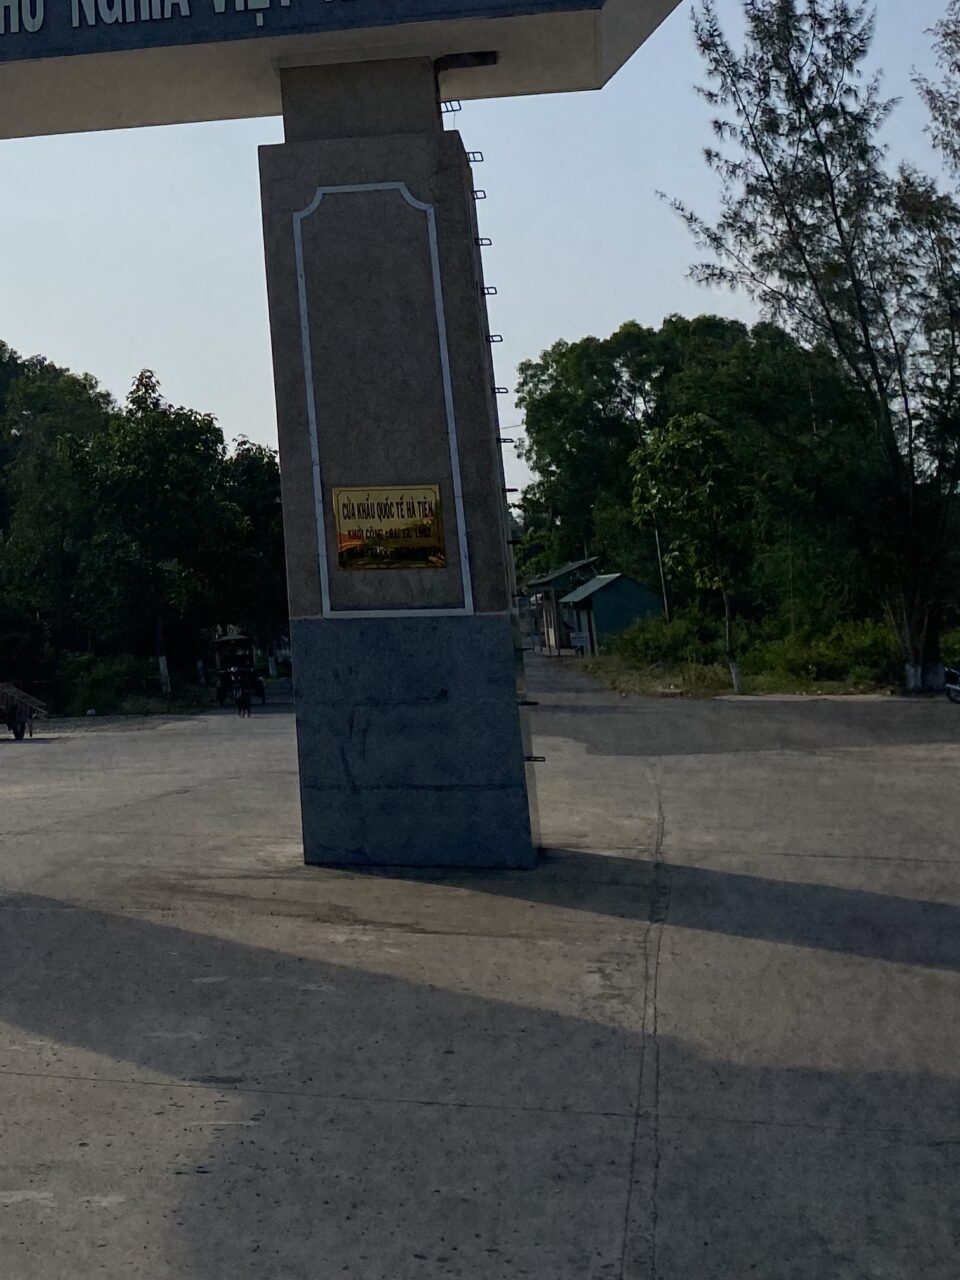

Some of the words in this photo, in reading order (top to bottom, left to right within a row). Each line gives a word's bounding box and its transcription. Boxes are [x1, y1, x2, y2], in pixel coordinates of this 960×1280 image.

[342, 496, 356, 520] CỬA
[357, 493, 376, 520] KHẨU
[377, 496, 395, 523] QUỐC
[396, 494, 406, 519] TẾ
[406, 496, 417, 519] HÀ
